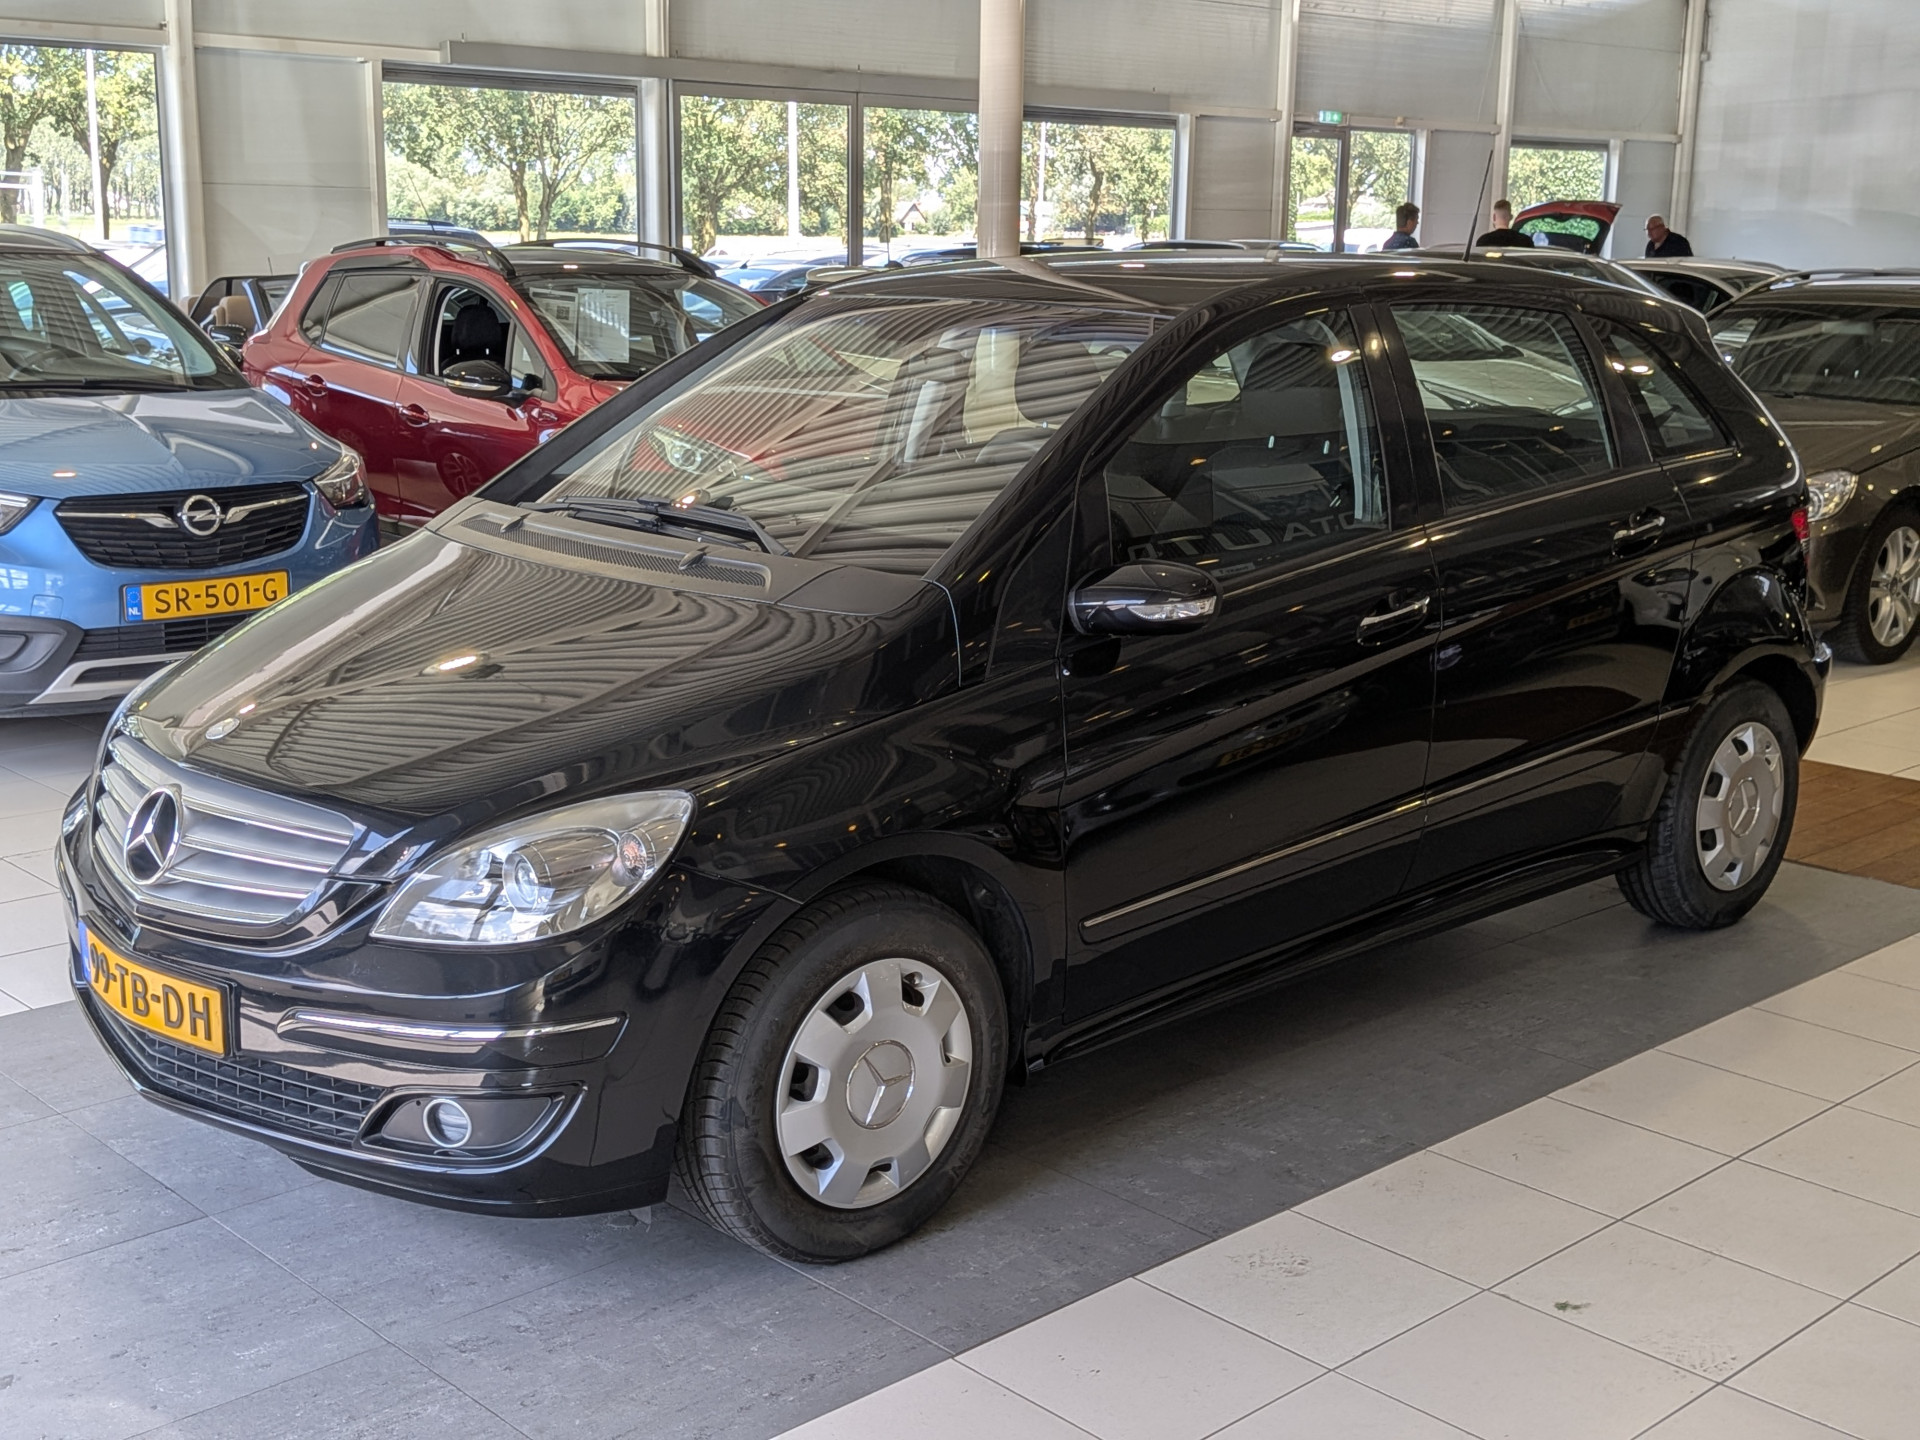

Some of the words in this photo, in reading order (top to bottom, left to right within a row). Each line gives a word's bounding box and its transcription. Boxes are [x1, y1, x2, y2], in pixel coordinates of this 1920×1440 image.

[128, 606, 141, 616] NL
[154, 578, 278, 614] SR-501-G
[89, 942, 212, 1042] 99-TB-DH
